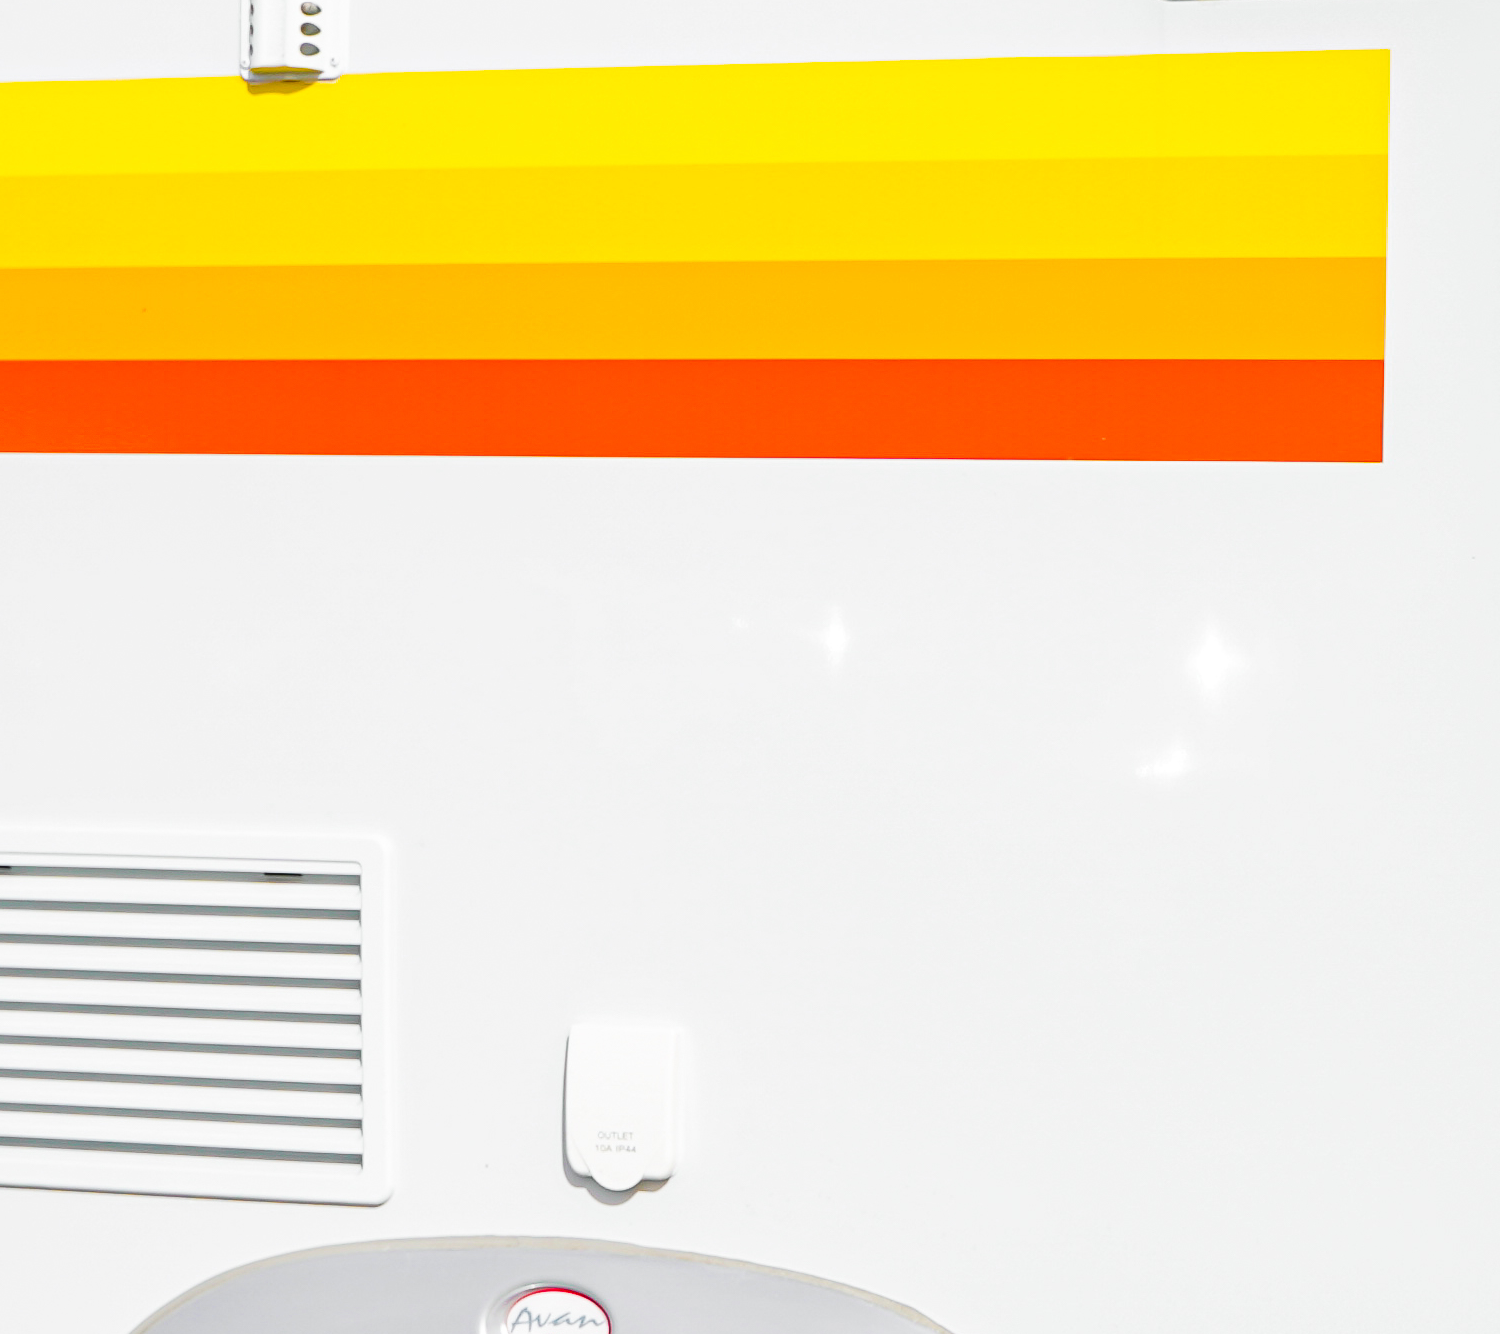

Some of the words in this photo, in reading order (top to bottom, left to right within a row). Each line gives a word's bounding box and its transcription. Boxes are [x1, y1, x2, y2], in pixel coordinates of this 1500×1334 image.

[597, 1130, 633, 1140] OUTLET
[595, 1144, 612, 1152] 10A
[615, 1144, 636, 1153] IP44
[511, 1306, 605, 1333] Avan
